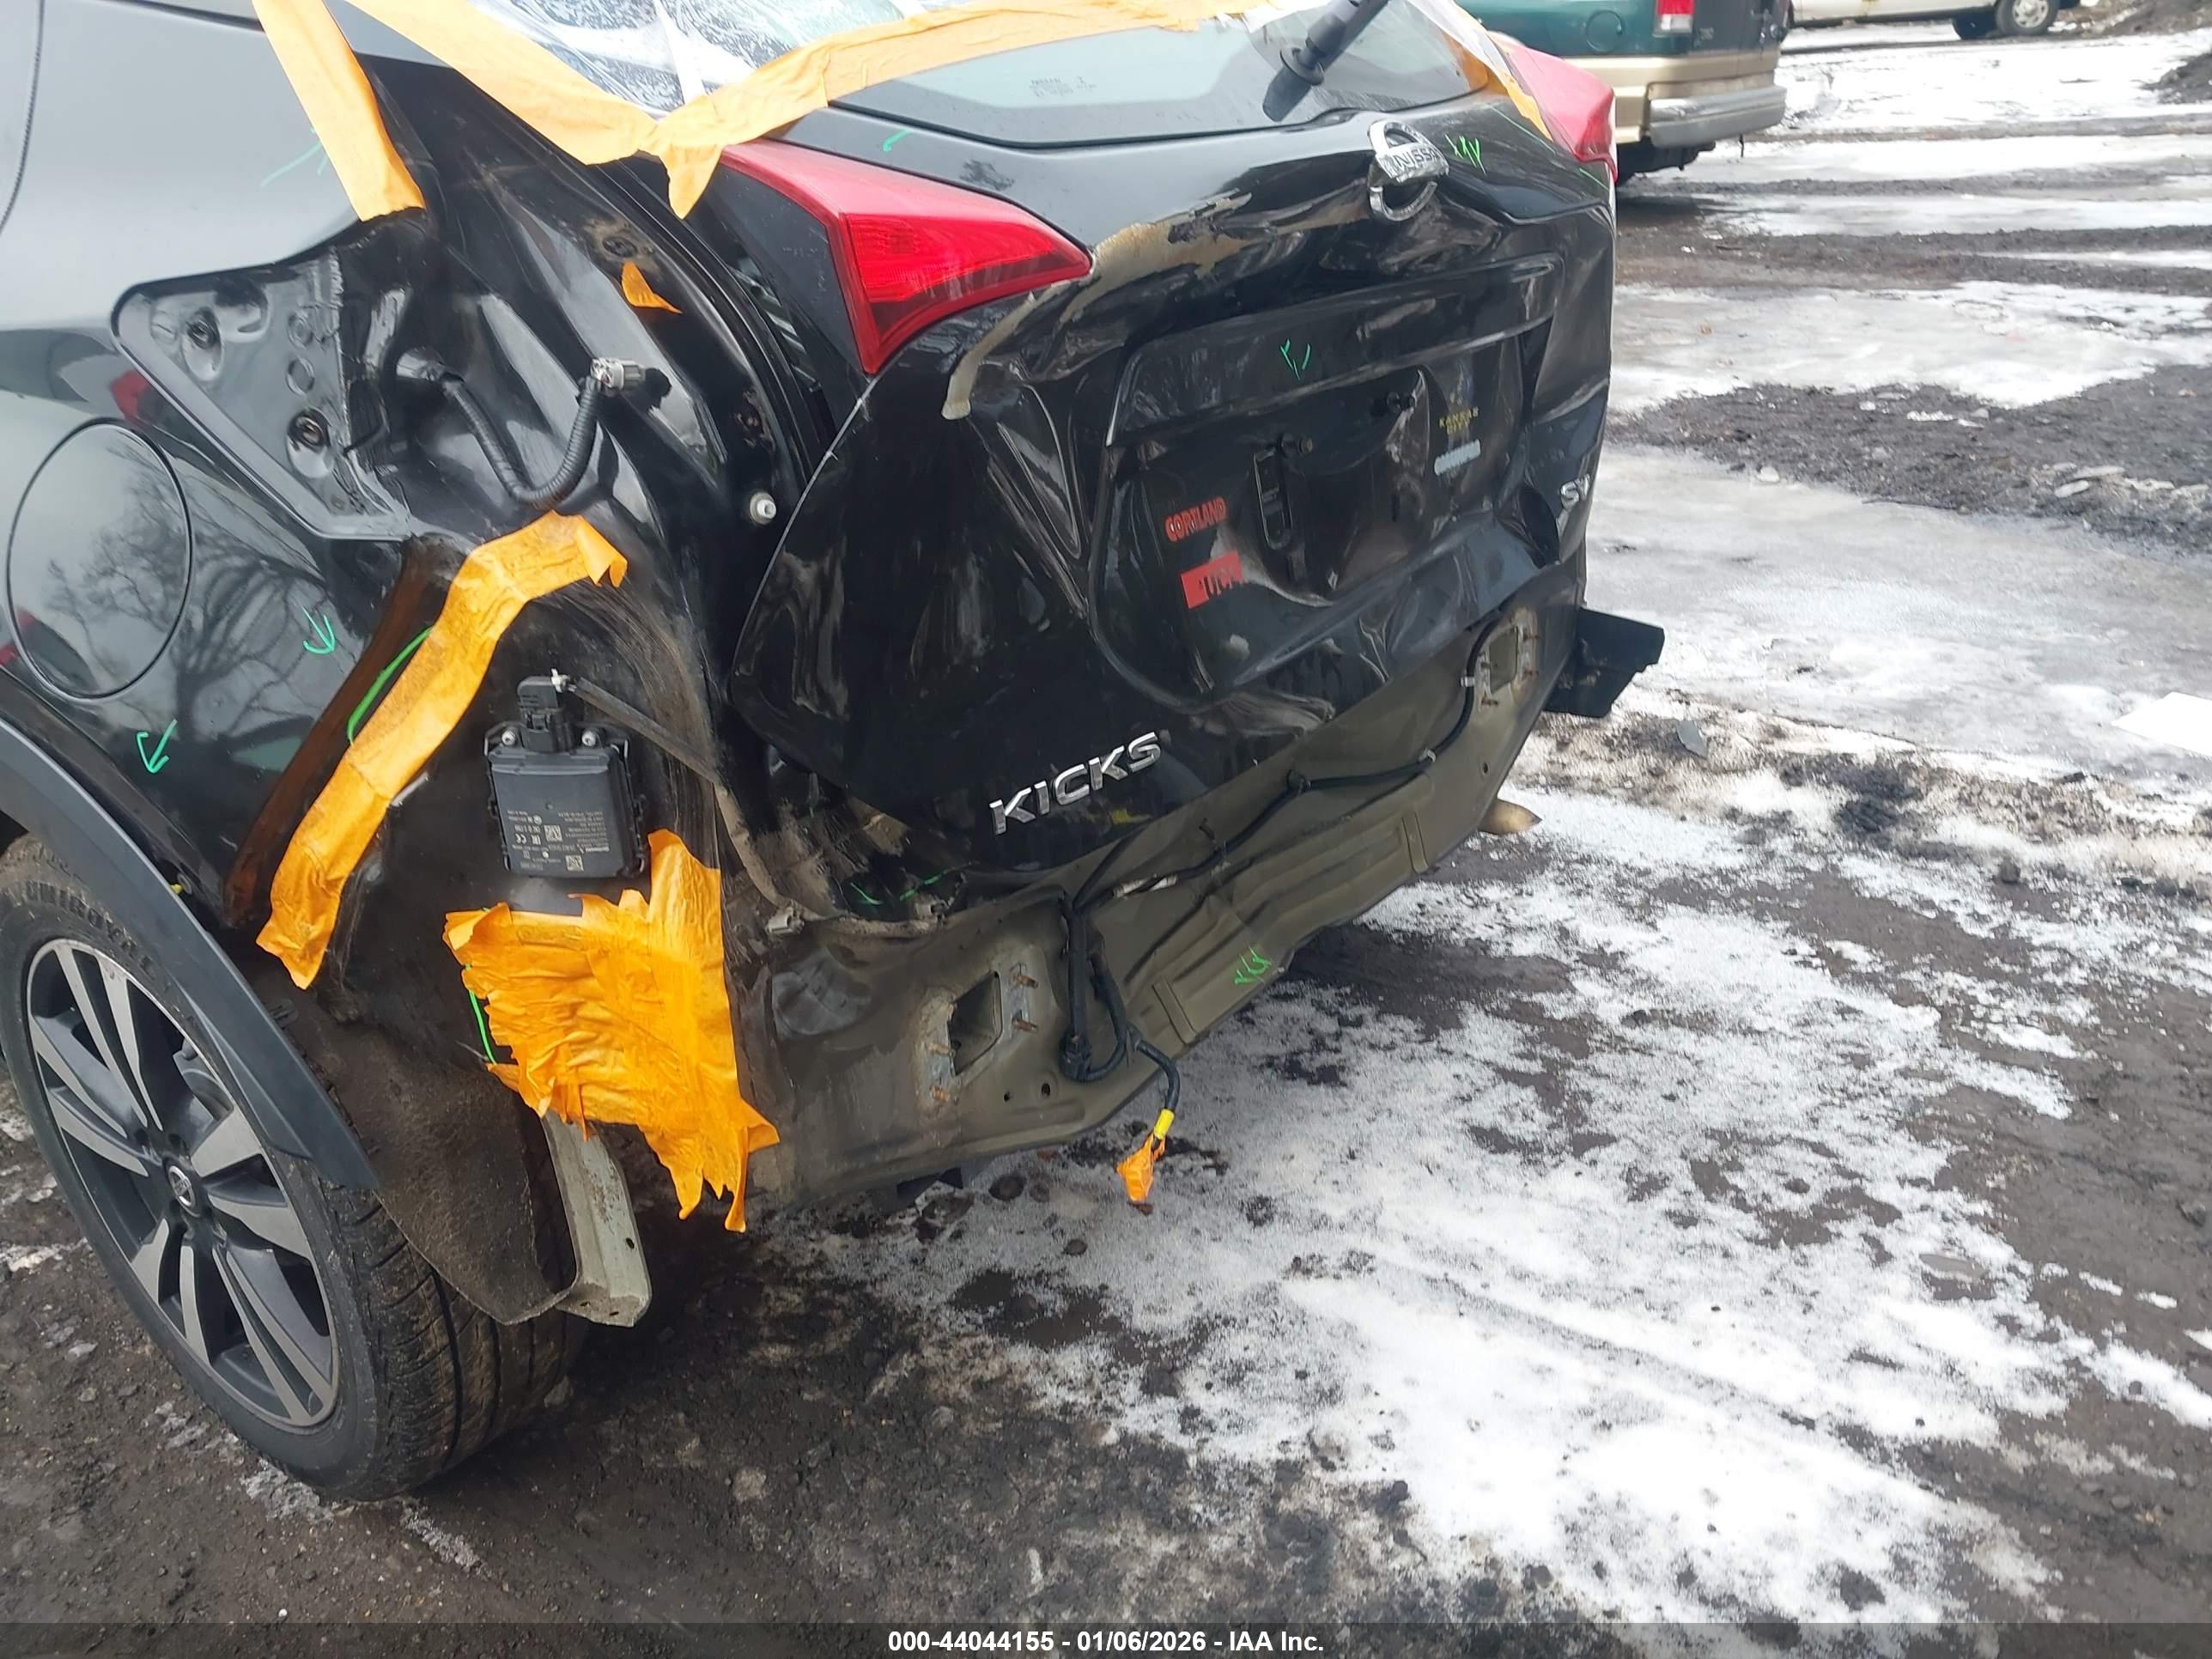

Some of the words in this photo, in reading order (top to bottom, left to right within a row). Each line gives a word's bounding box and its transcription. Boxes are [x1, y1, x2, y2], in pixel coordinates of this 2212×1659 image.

[1392, 147, 1441, 171] NISSA
[1165, 495, 1226, 543] CORTLAND
[989, 732, 1161, 836] KICKS
